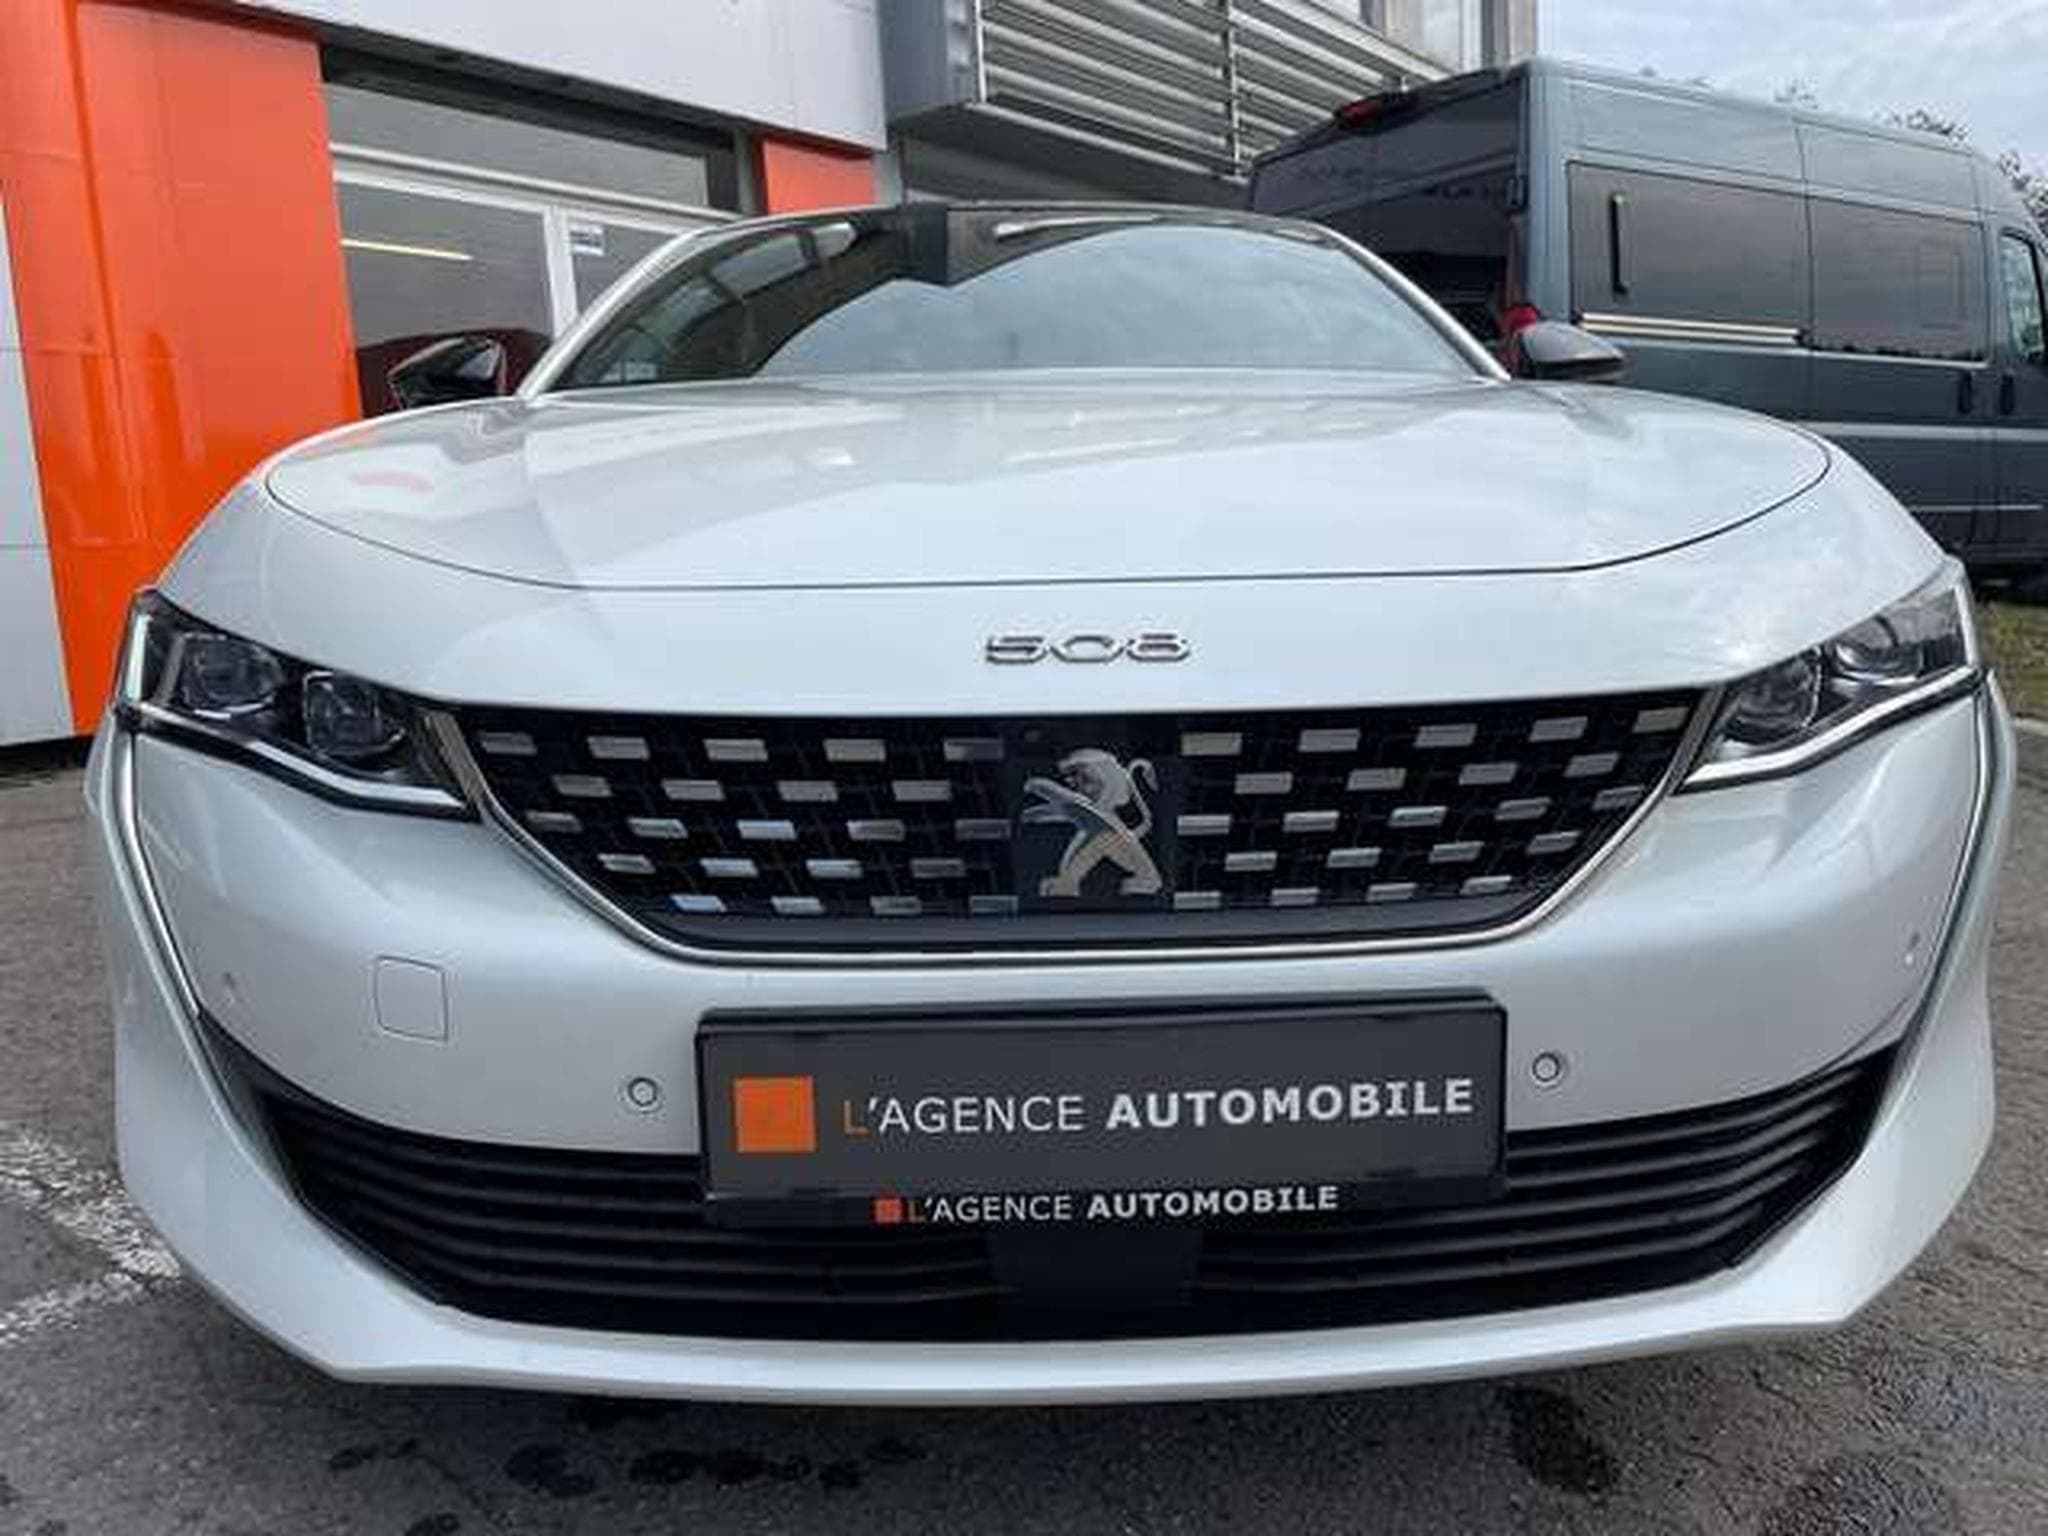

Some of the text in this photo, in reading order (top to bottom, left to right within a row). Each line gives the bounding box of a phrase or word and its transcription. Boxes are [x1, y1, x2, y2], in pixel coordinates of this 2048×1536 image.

[985, 633, 1191, 664] 508
[843, 1079, 1474, 1134] L'AGENCE AUTOMOBILE
[1087, 1186, 1338, 1220] AUTOMOBILE
